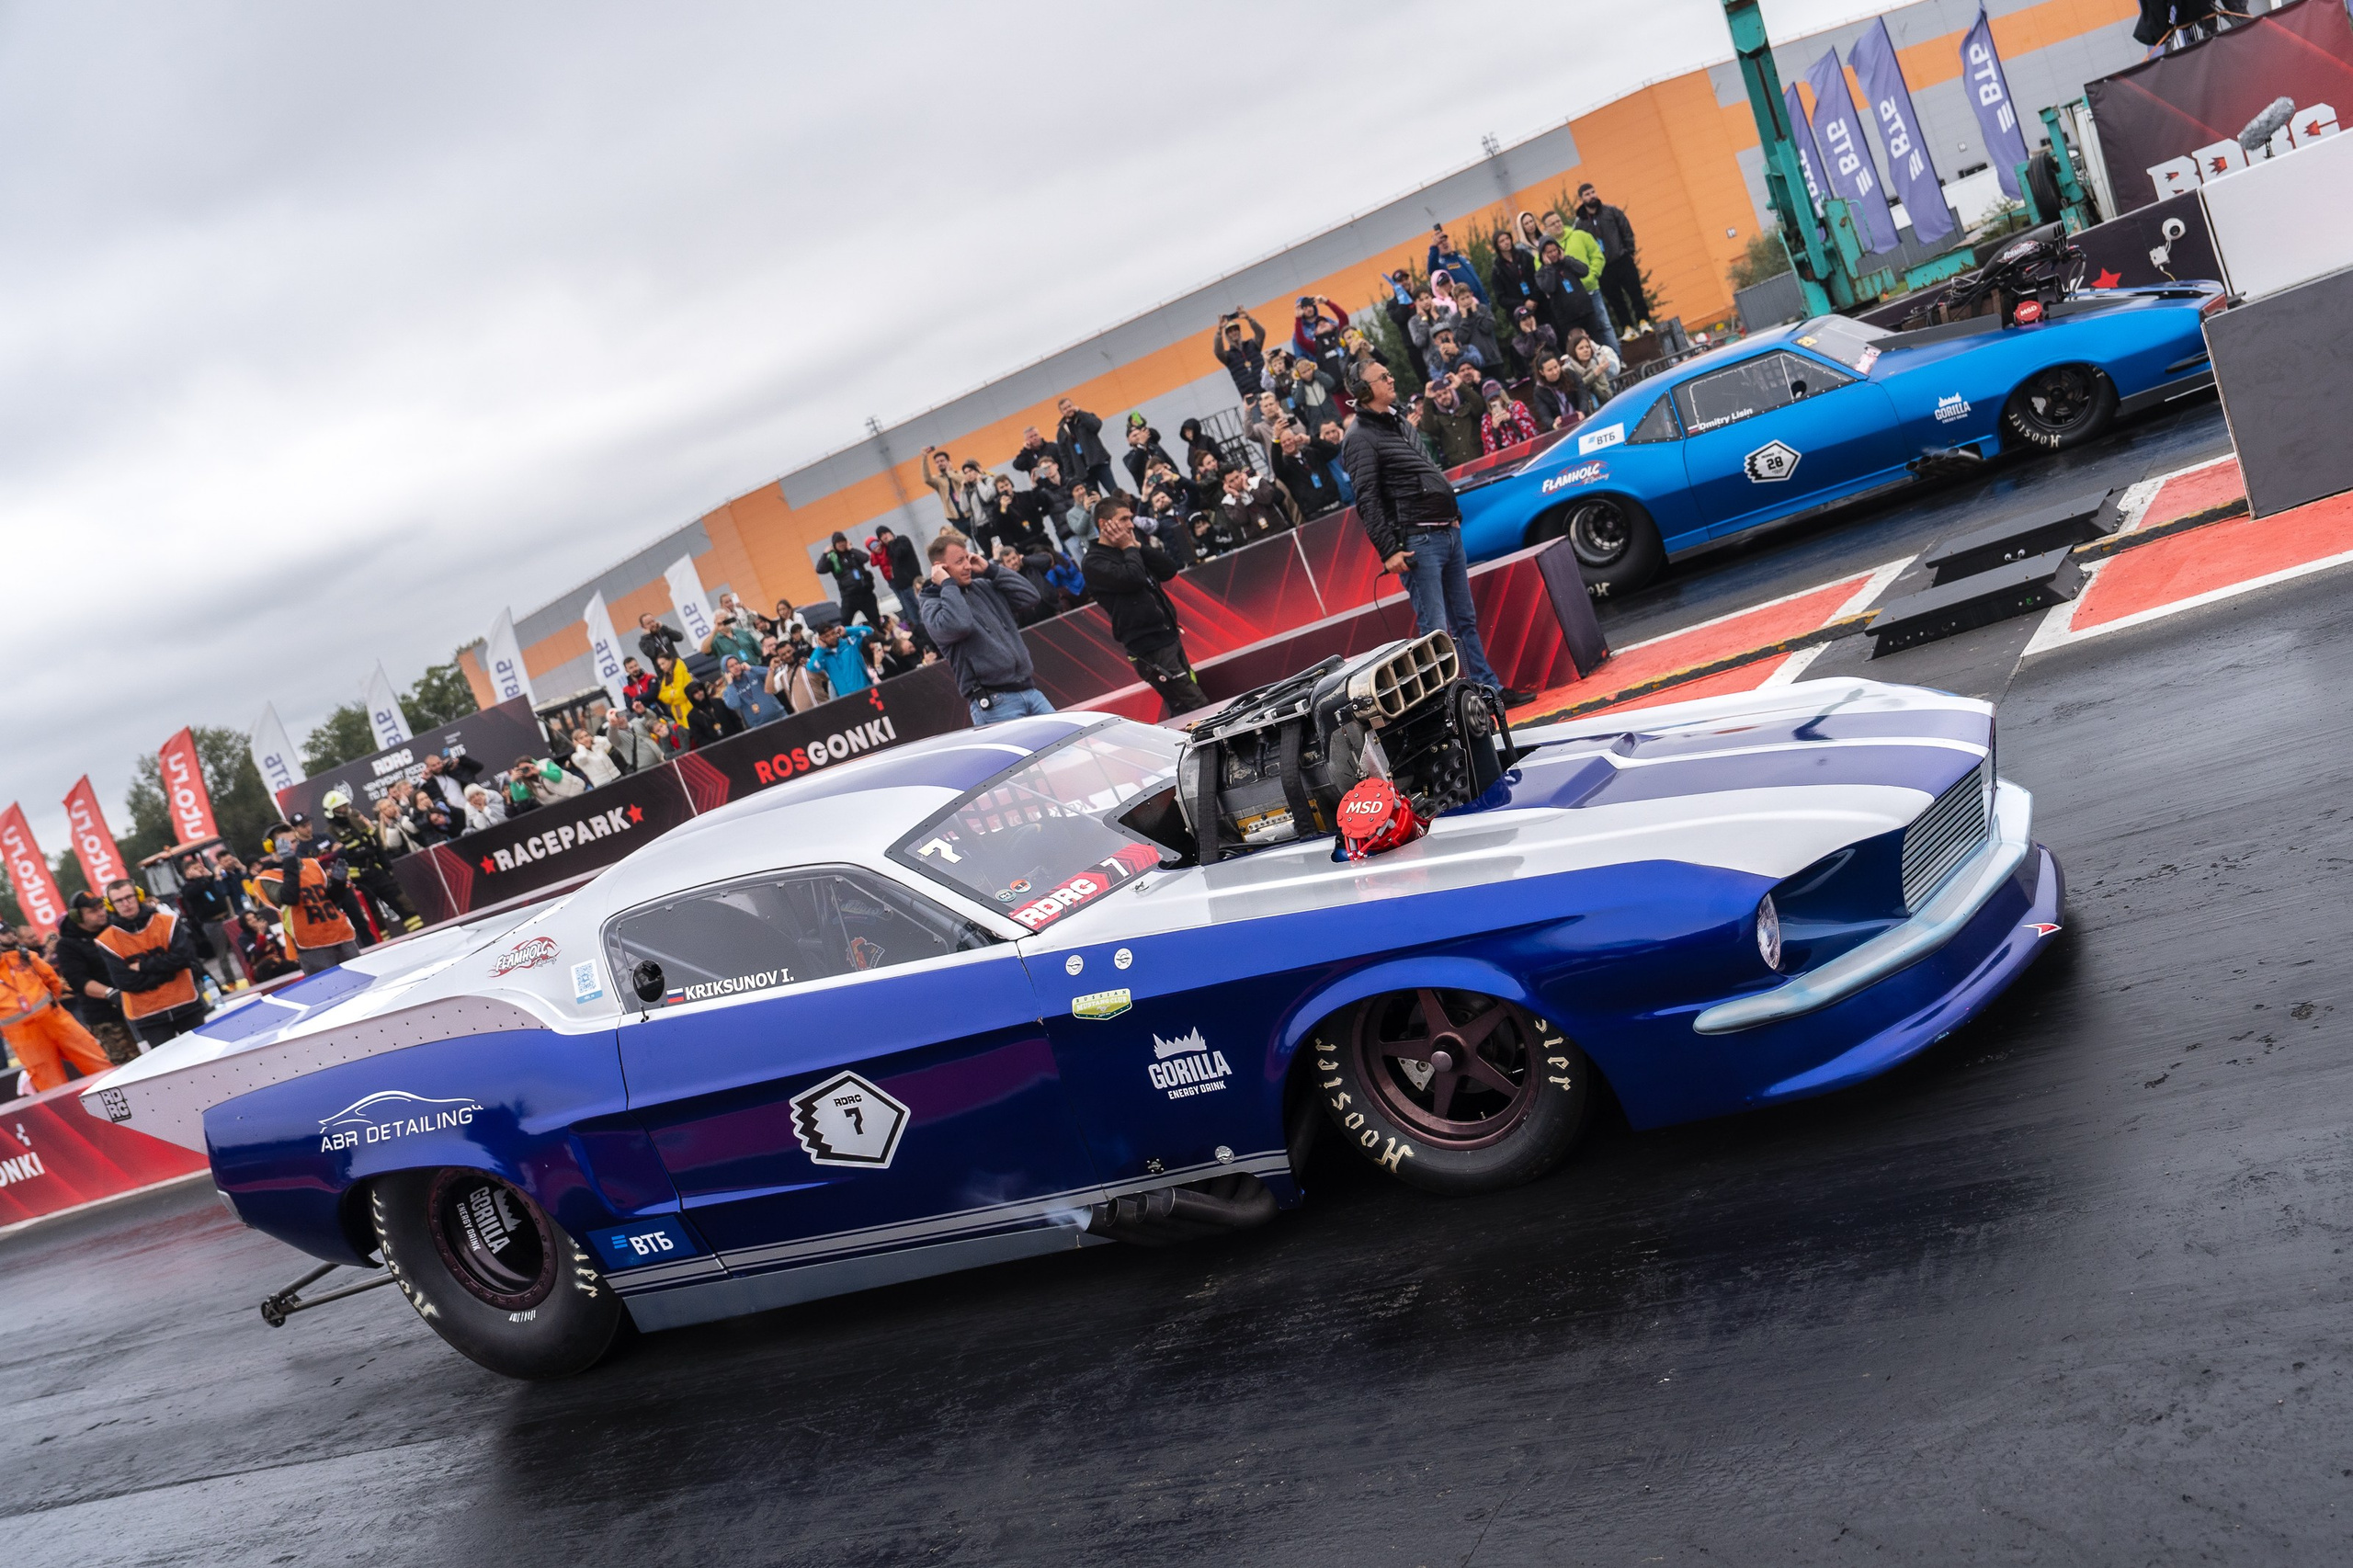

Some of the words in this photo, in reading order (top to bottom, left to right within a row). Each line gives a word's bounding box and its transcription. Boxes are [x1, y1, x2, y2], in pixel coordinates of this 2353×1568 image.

[2019, 303, 2038, 317] MSD
[1699, 414, 1730, 431] Dmitry
[1732, 407, 1754, 420] Lisin
[1934, 401, 1972, 421] GORILLA
[1597, 432, 1616, 446] ВТБ
[1766, 456, 1784, 471] 28
[1541, 461, 1600, 494] FLAMHOLC
[370, 747, 415, 778] RDRC
[754, 715, 897, 784] ROSGONKI
[1346, 801, 1383, 814] MSD
[493, 806, 631, 871] RACEPARK
[917, 837, 962, 864] 7
[1014, 879, 1098, 927] RDRC
[1100, 857, 1130, 878] 7
[494, 940, 550, 972] FLAMHOLC
[685, 970, 778, 1000] KRIKSUNOV
[781, 968, 794, 983] I.
[1076, 990, 1126, 1003] RUSSIAN
[1076, 998, 1109, 1012] MUSTANG
[1148, 1051, 1233, 1089] GORILLA
[834, 1094, 862, 1107] RDRC
[1167, 1085, 1199, 1099] ENERGY
[1199, 1080, 1226, 1094] DRINK
[321, 1131, 358, 1153] ABR
[367, 1107, 472, 1143] DETAILING
[844, 1107, 864, 1135] 7
[457, 1202, 473, 1228] ENERGY
[466, 1228, 481, 1251] DRINK
[470, 1186, 510, 1255] GORILLA
[629, 1231, 674, 1256] ВТБ
